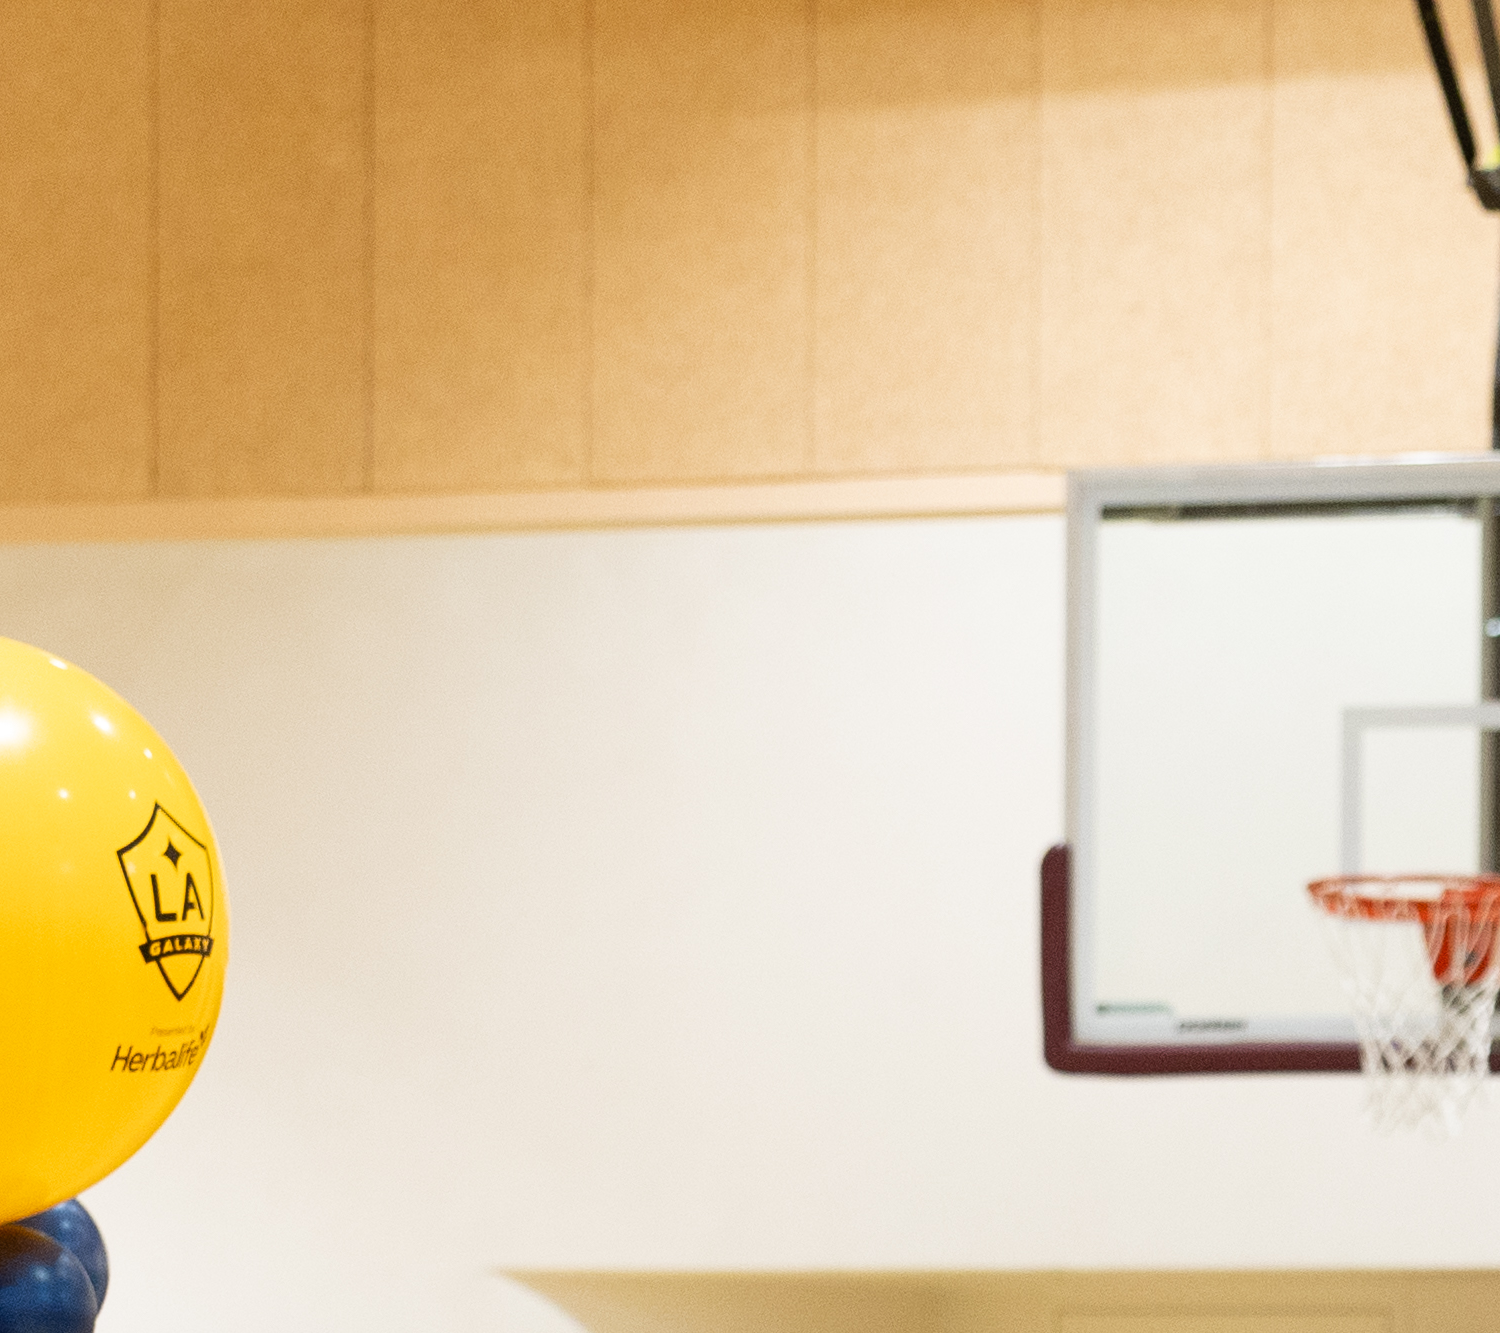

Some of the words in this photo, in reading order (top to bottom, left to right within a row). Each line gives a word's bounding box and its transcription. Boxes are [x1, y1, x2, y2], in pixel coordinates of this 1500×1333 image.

[150, 871, 206, 923] LA
[148, 936, 211, 958] GALAXY
[109, 1039, 200, 1073] Herbalife
